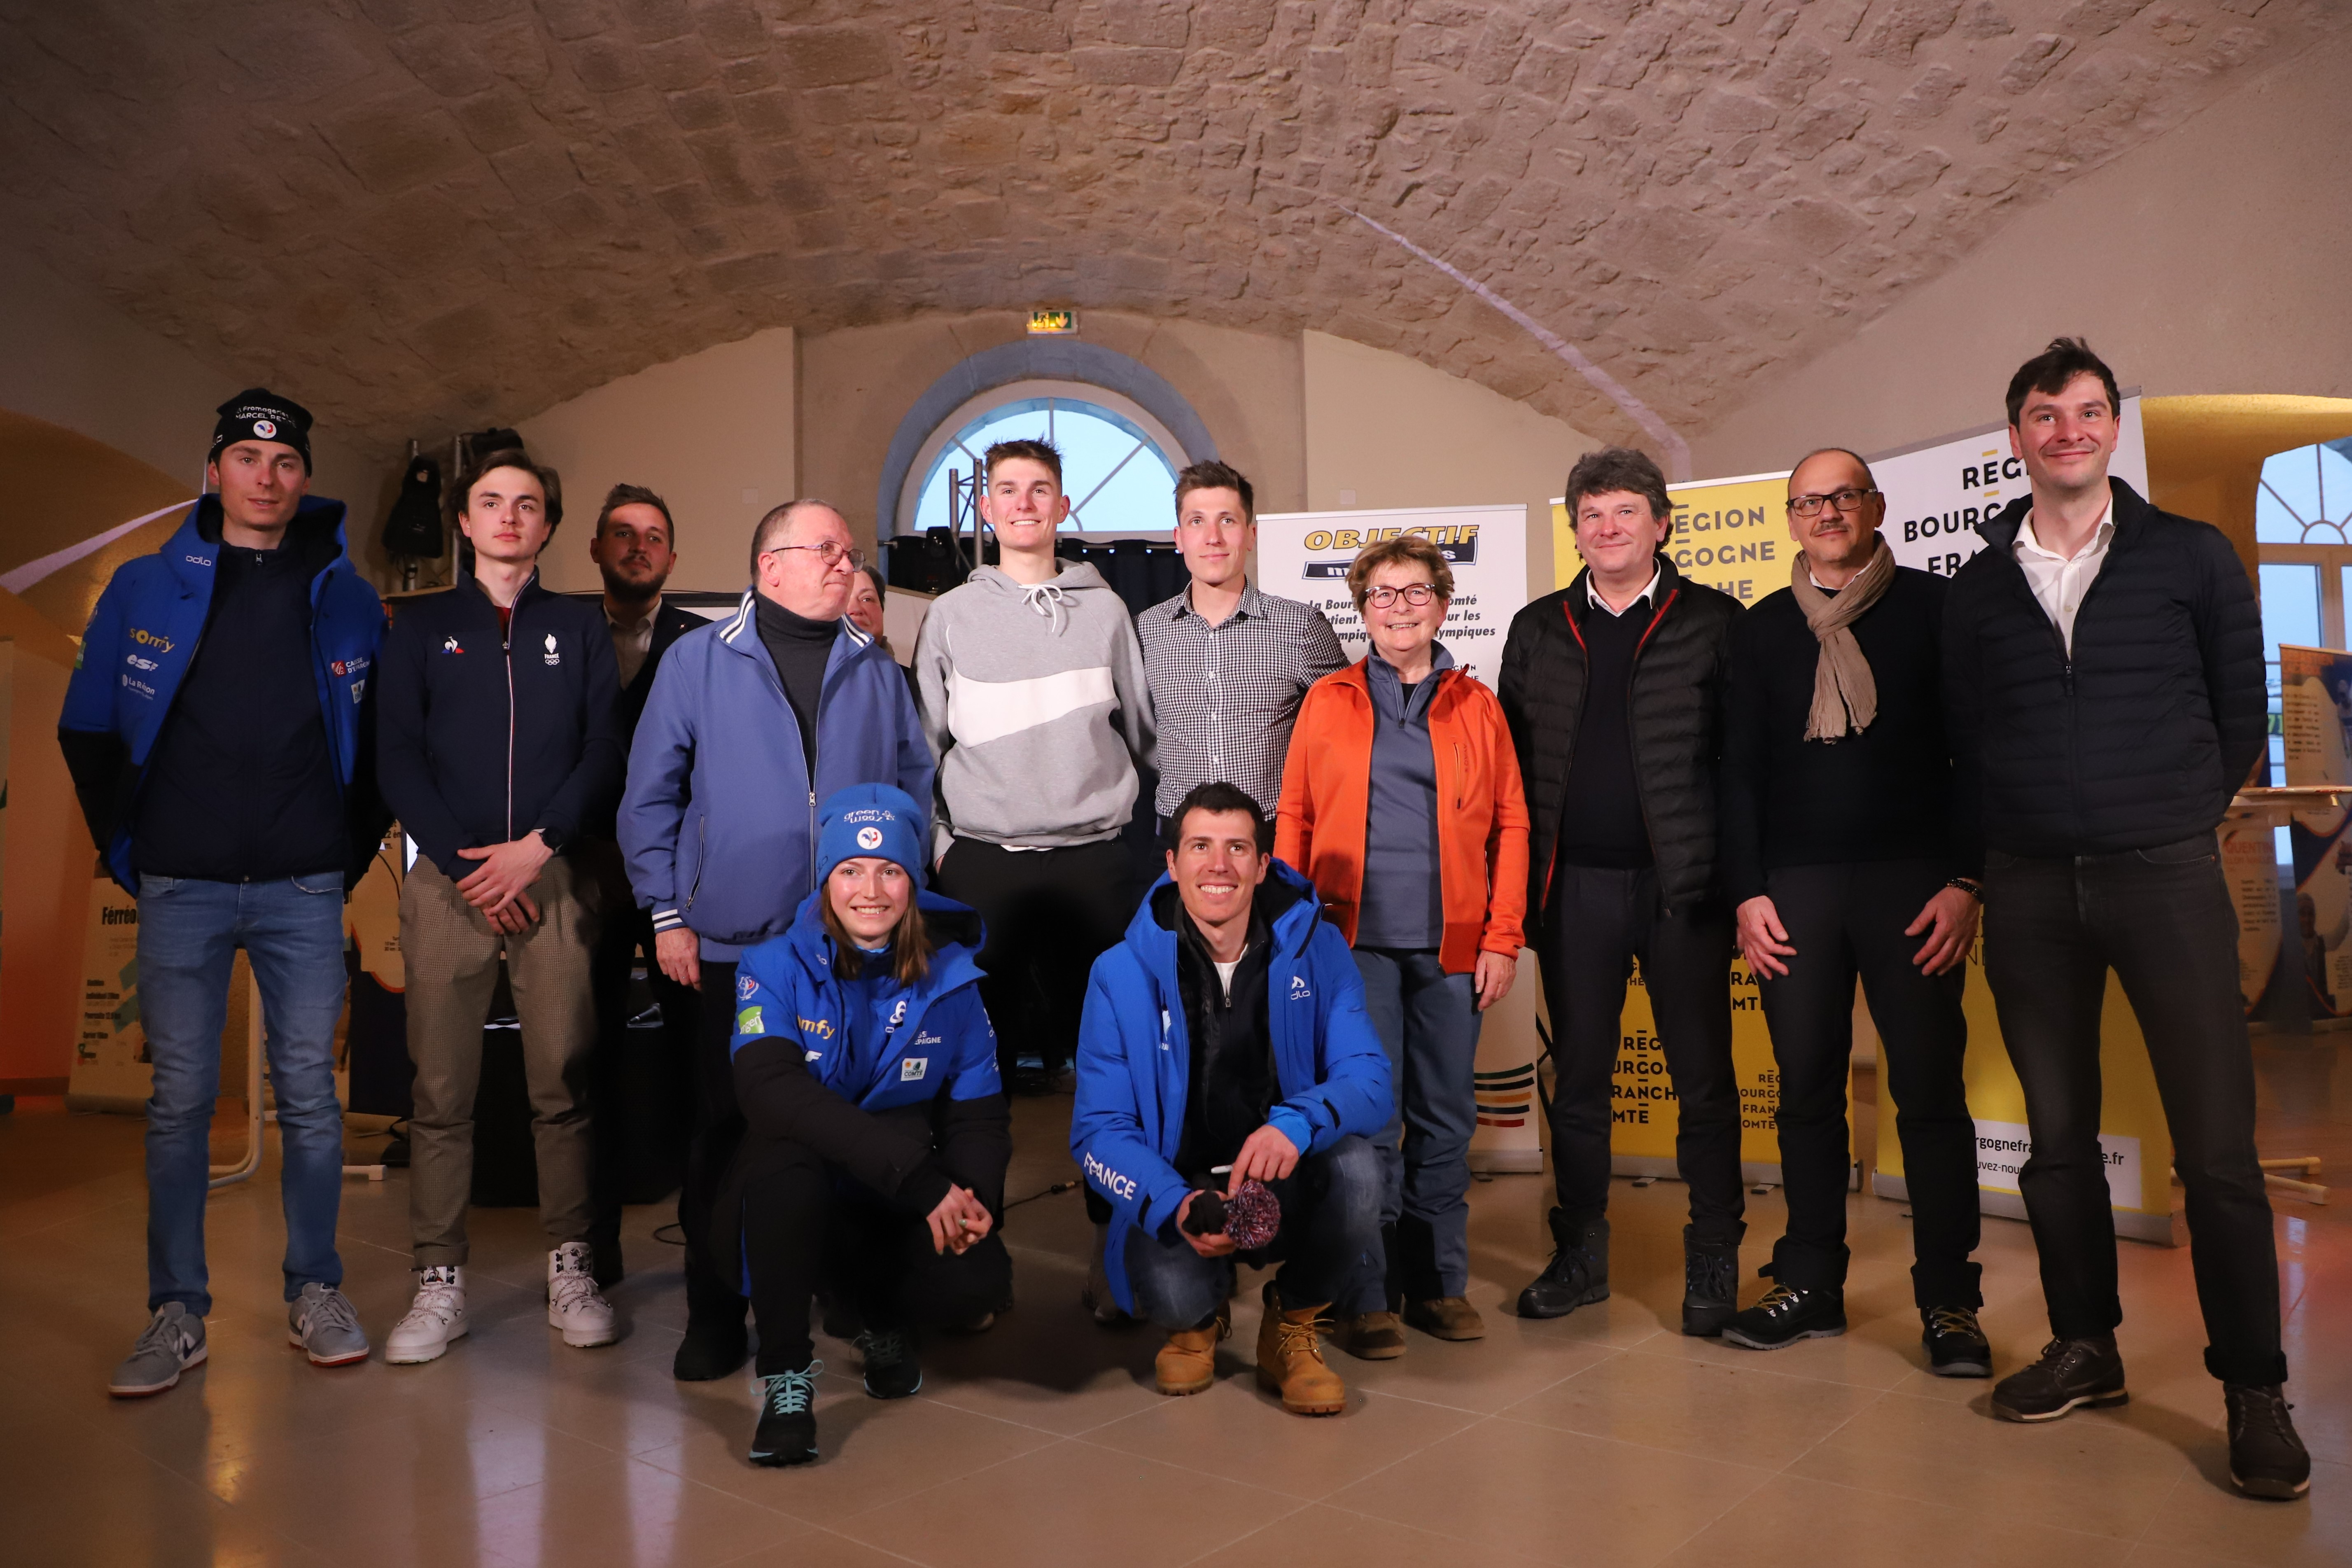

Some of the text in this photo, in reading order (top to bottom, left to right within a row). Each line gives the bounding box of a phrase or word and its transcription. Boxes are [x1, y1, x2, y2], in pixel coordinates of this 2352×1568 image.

[1962, 457, 2030, 490] REG
[1675, 506, 1765, 534] EGION
[186, 555, 212, 567] odlo
[1463, 610, 1481, 621] les
[128, 677, 136, 686] La
[844, 809, 880, 822] green
[102, 905, 139, 925] Férréo
[1290, 989, 1311, 1001] dlo
[1612, 1085, 1677, 1101] RANCH
[1612, 1109, 1649, 1124] MTE
[1742, 1119, 1776, 1130] OMTE
[1084, 1152, 1137, 1201] FRANCE
